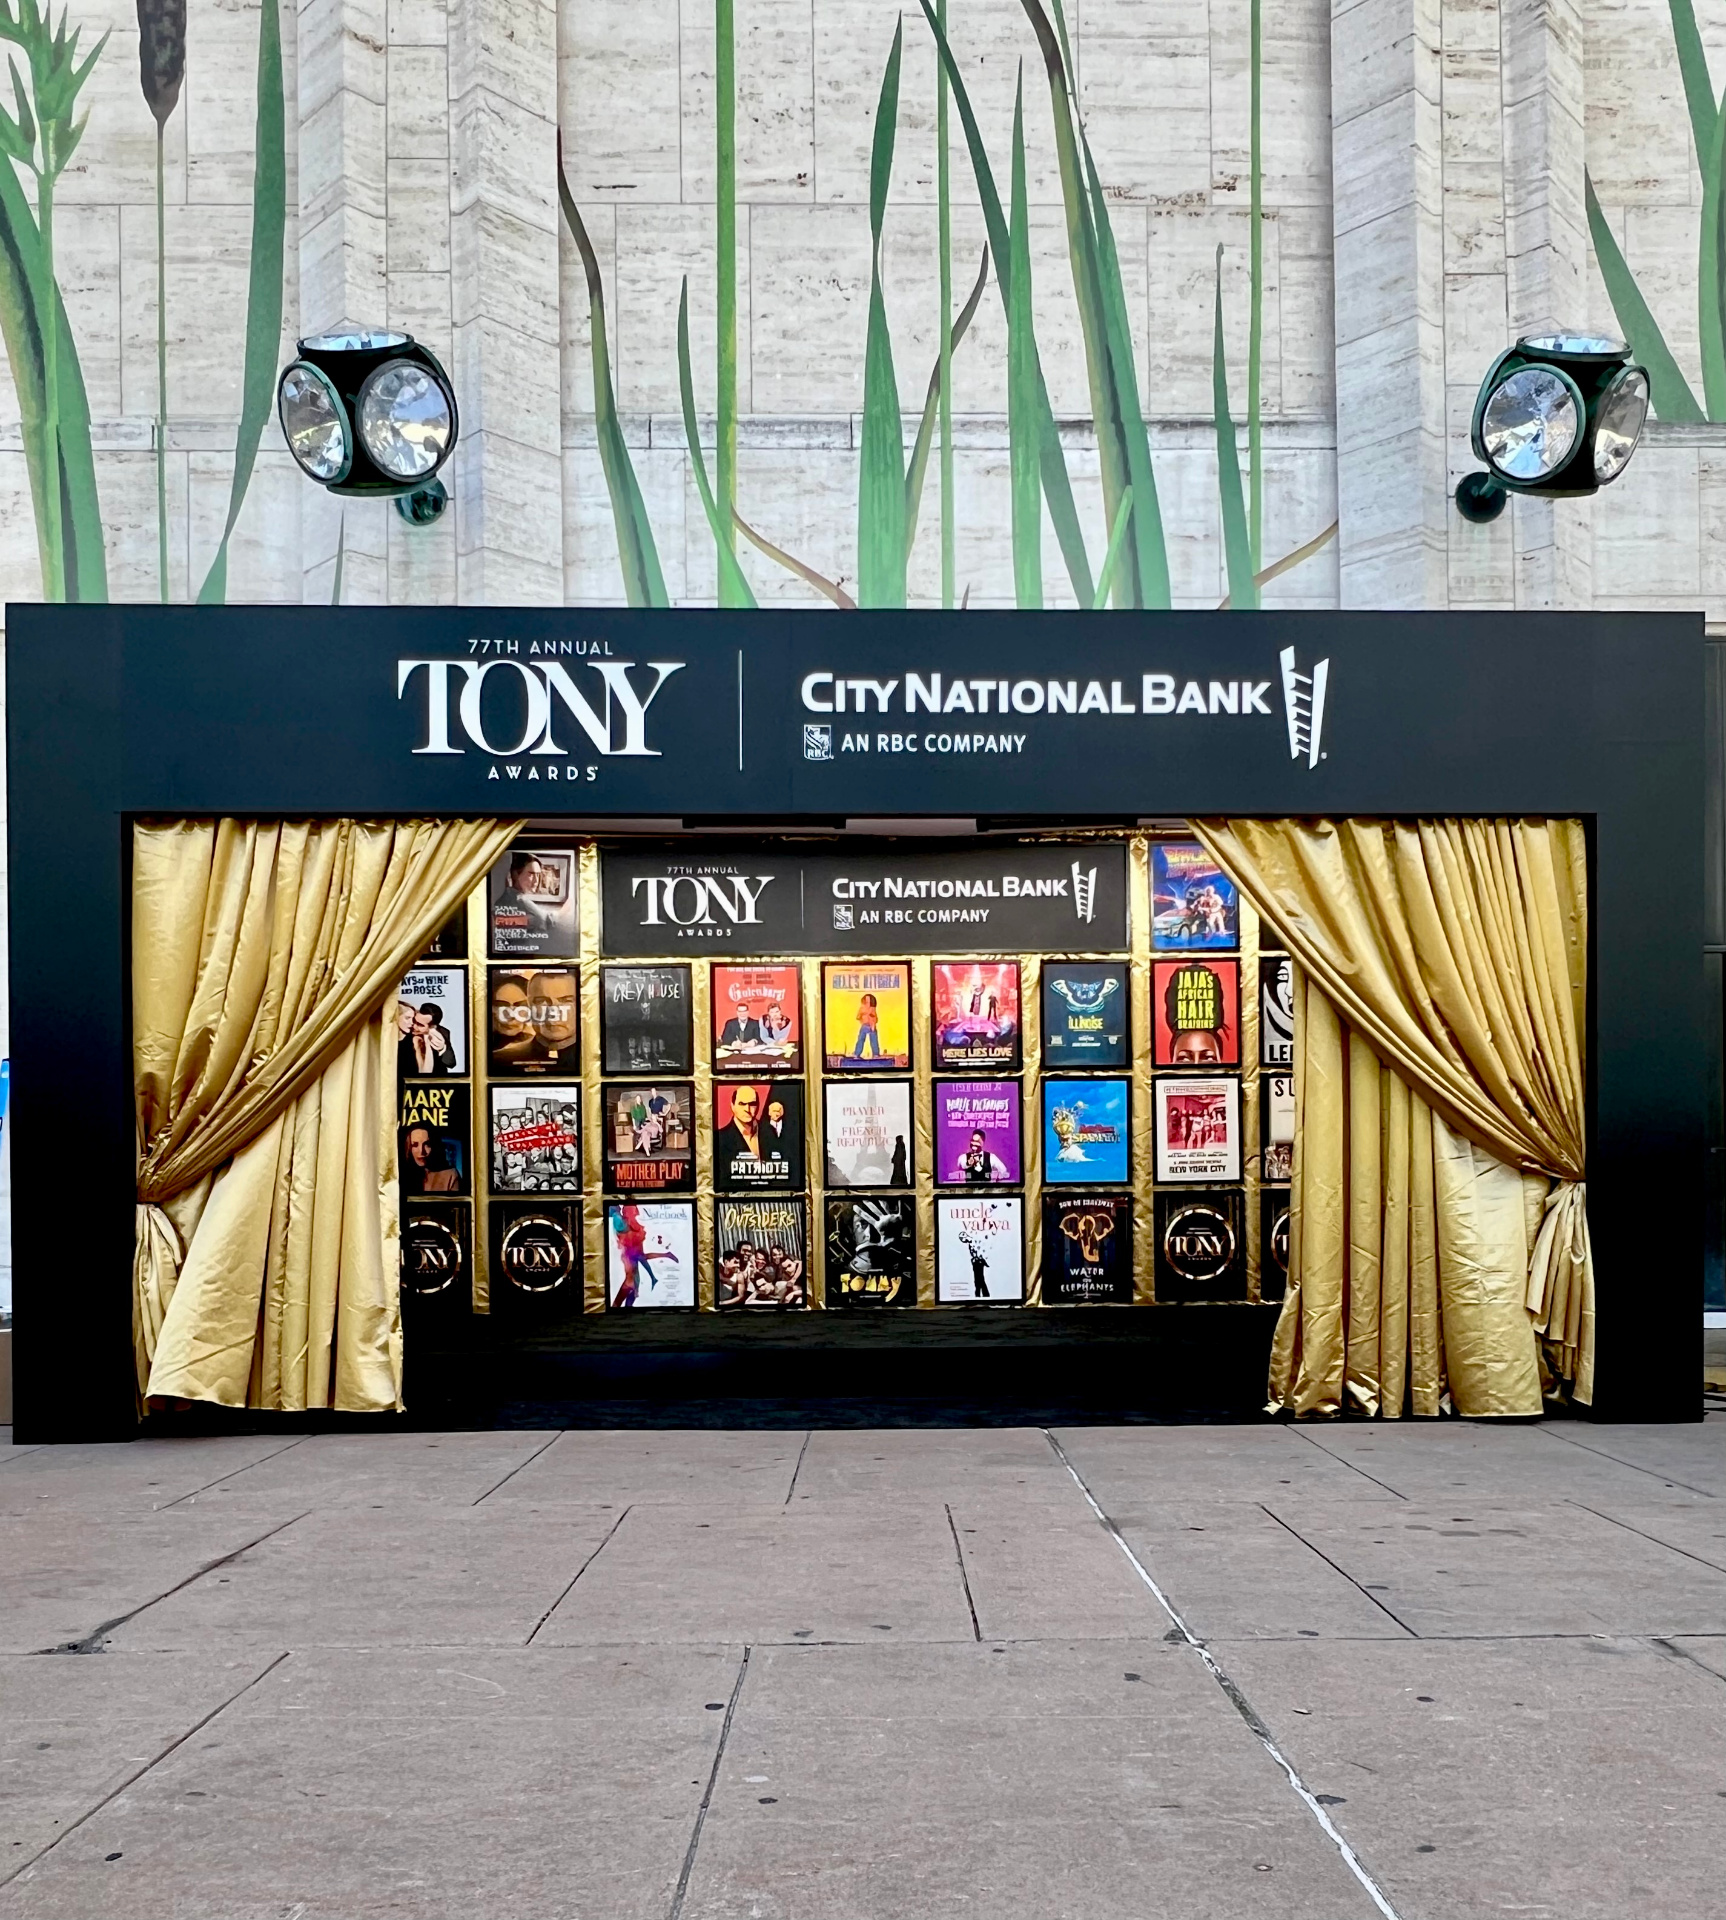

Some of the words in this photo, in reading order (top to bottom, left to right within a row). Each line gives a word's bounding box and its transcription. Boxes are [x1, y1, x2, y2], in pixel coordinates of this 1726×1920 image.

[468, 640, 519, 654] 77TH
[529, 641, 614, 656] ANNUAL
[398, 660, 687, 756] TONY
[841, 735, 870, 752] AN
[877, 735, 918, 752] RBC
[925, 734, 1027, 752] COMPANY
[488, 766, 599, 781] AWARDS
[667, 866, 693, 875] 77TH
[697, 866, 740, 875] ANNUAL
[632, 876, 776, 925] TONY
[860, 910, 879, 924] AN
[884, 910, 912, 924] RBC
[917, 909, 991, 924] COMPANY
[677, 929, 732, 938] AWARDS
[401, 976, 417, 986] AYS
[413, 985, 443, 995] ROSES
[1178, 1000, 1214, 1019] HAIR
[616, 1163, 657, 1180] MOTHER
[659, 1162, 683, 1180] PLAY
[950, 1202, 994, 1219] uncle
[1169, 1235, 1228, 1257] TONY
[507, 1246, 567, 1268] TONY
